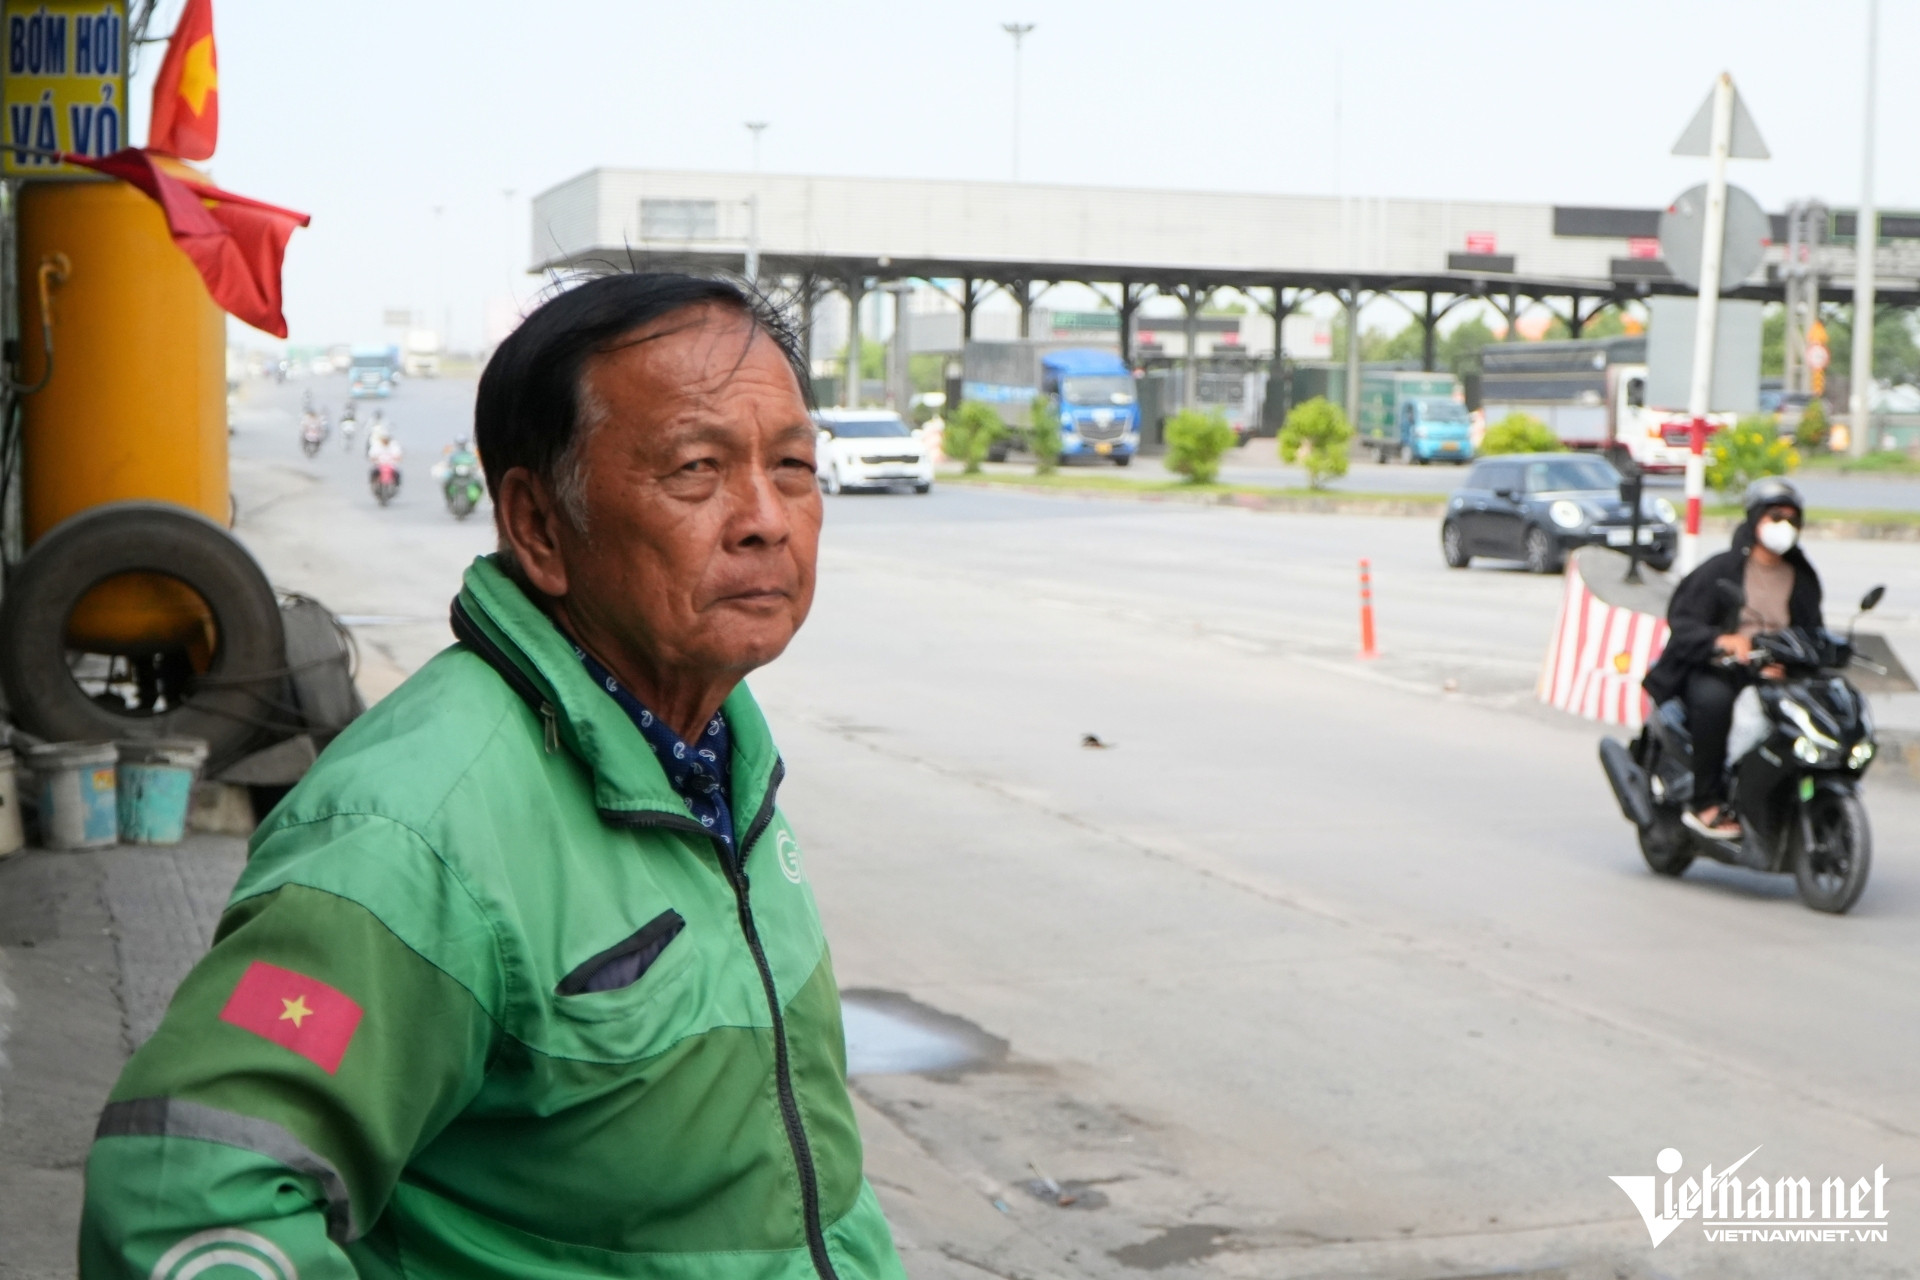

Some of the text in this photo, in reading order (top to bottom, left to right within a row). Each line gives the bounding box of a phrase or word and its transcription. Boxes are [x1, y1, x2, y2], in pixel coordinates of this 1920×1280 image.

[10, 4, 119, 75] BƠM HƠI
[10, 83, 117, 165] VÁ VỎ
